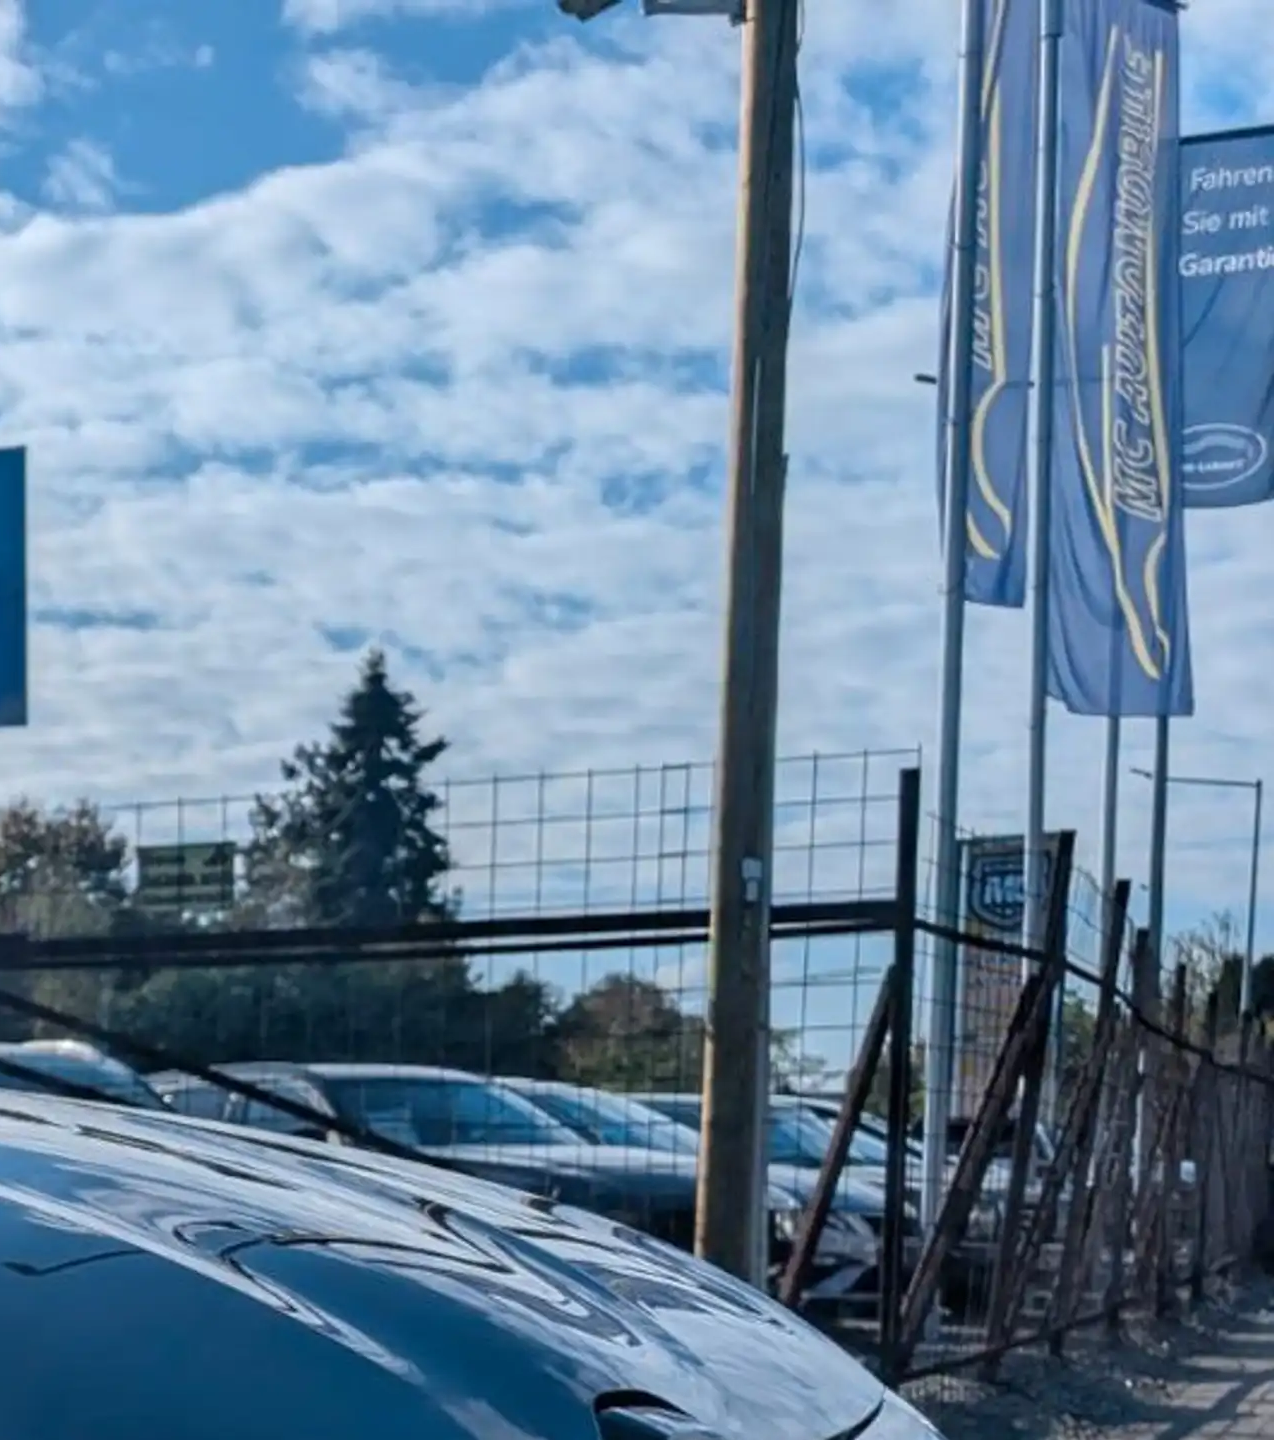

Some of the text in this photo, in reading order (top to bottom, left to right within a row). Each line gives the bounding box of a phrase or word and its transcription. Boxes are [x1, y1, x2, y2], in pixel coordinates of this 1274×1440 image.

[1190, 166, 1272, 191] Fahren
[1182, 204, 1270, 234] Sie mit
[1178, 246, 1274, 277] Garanti
